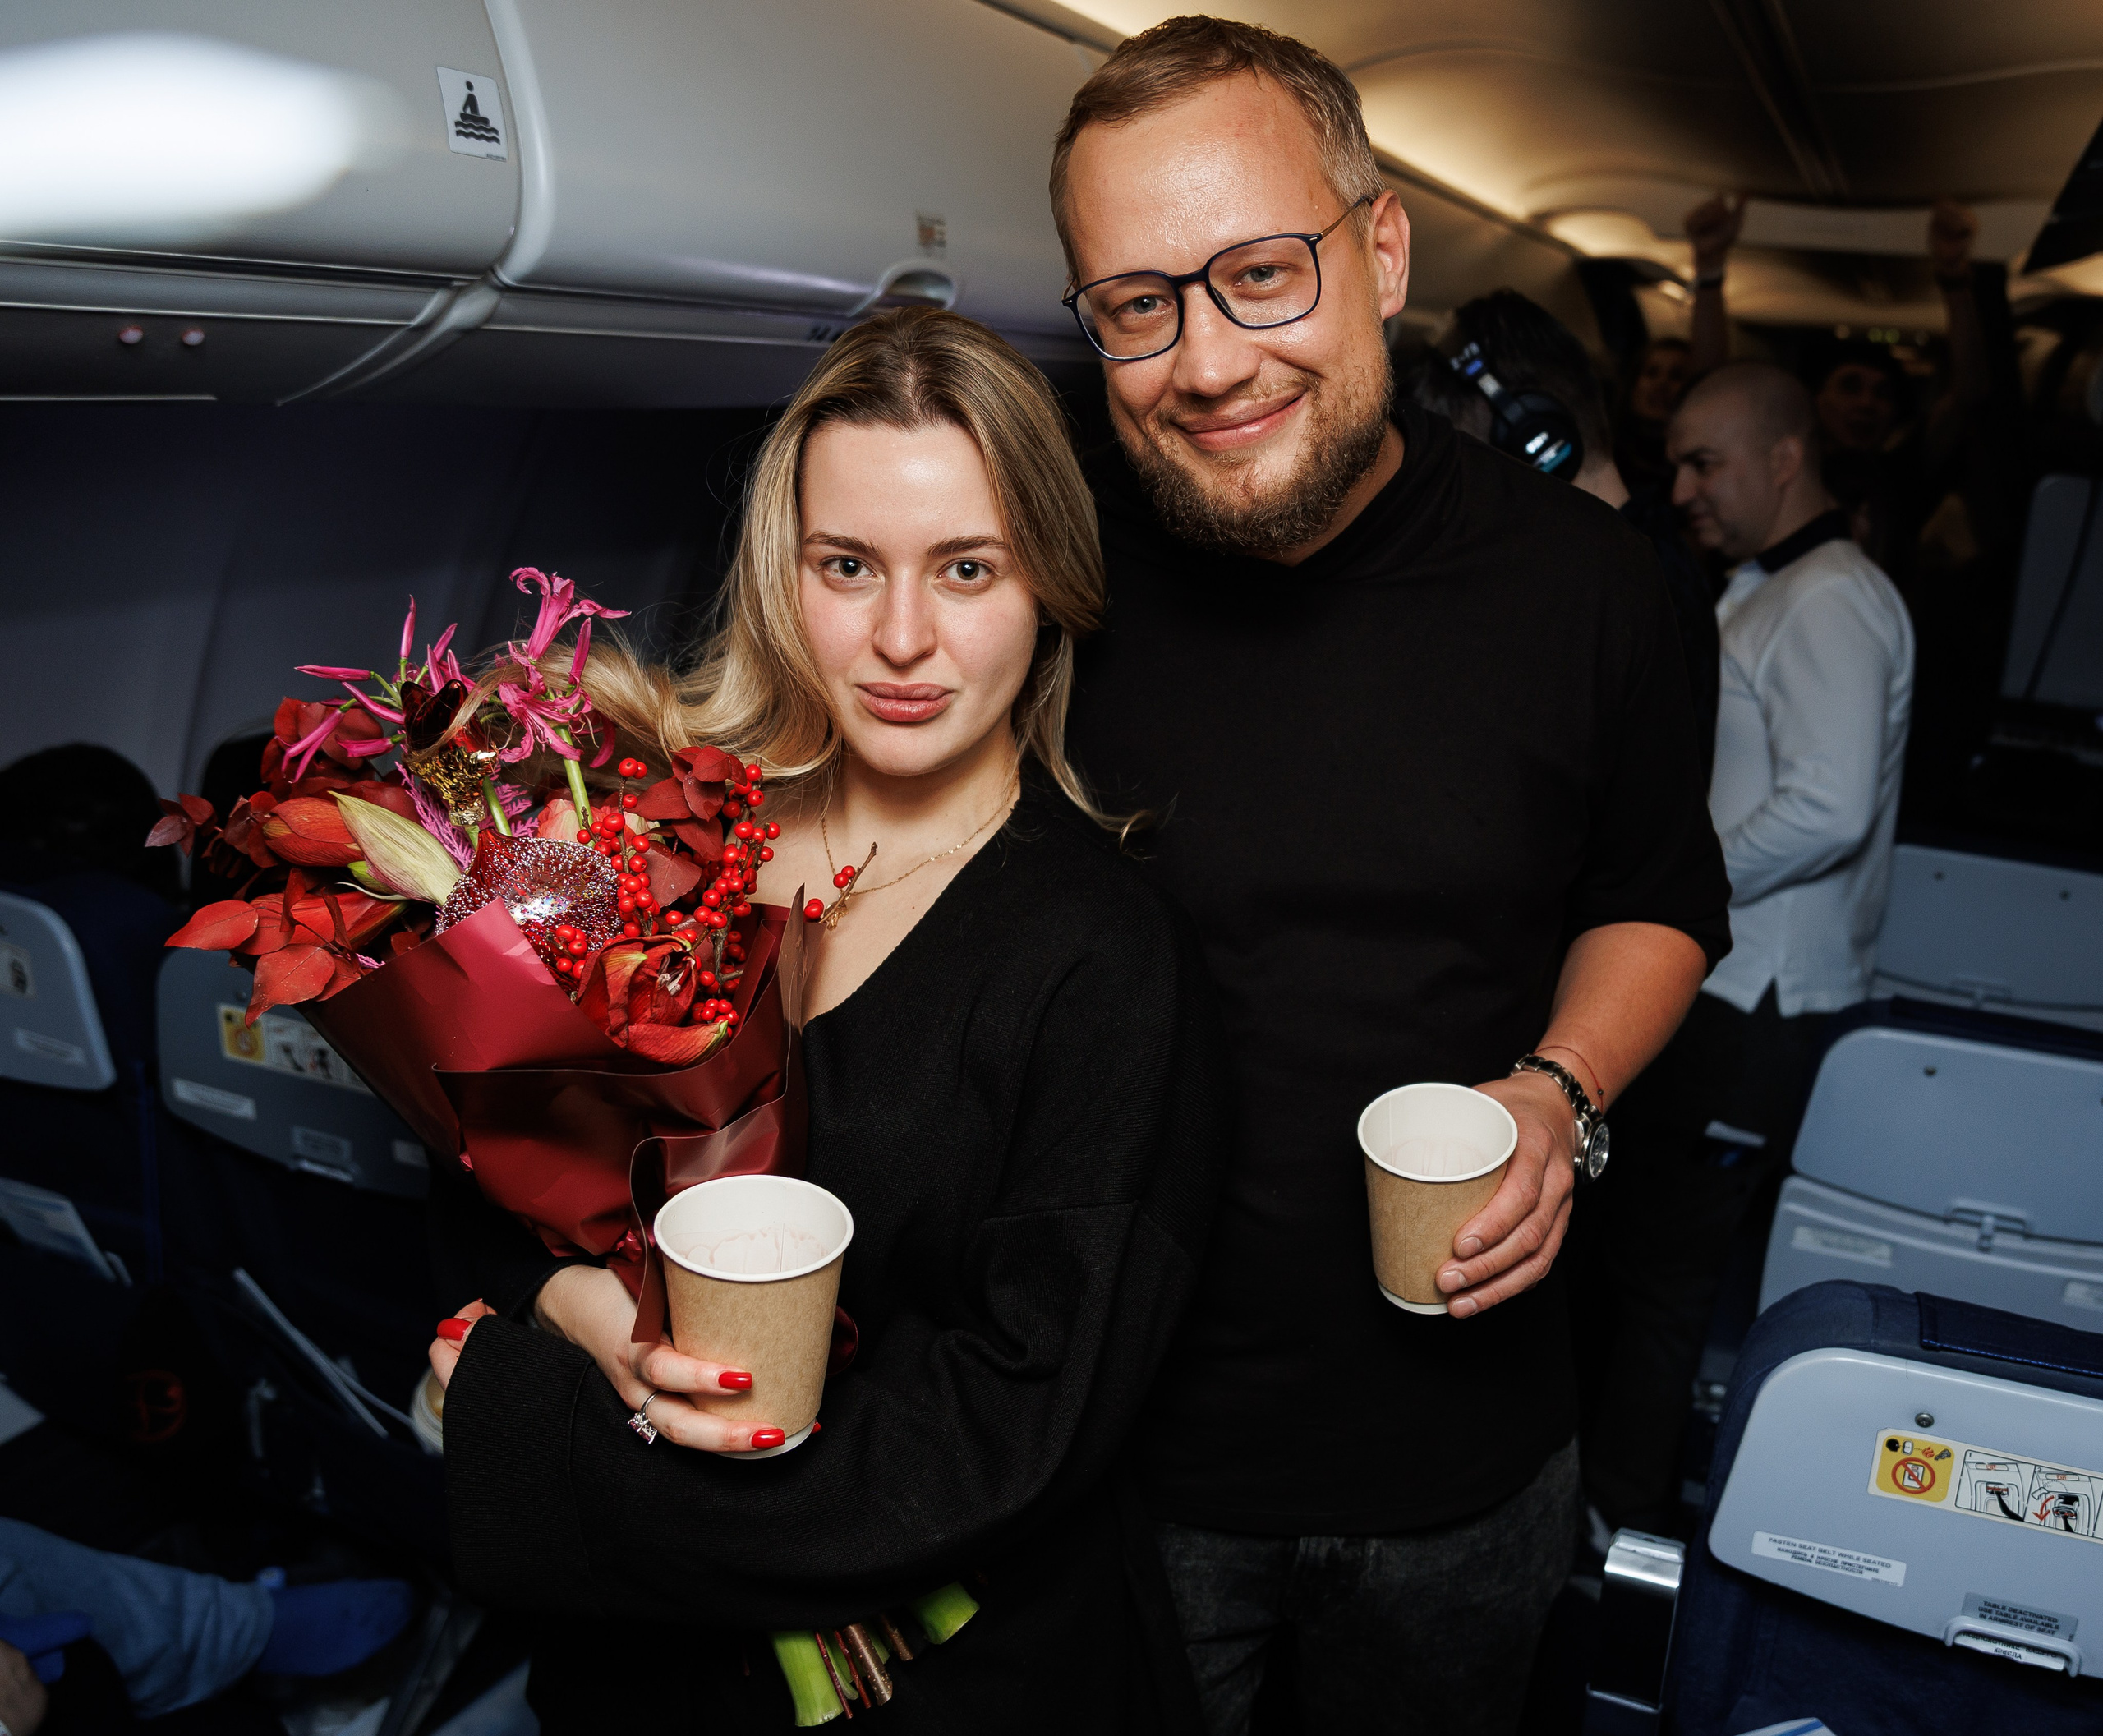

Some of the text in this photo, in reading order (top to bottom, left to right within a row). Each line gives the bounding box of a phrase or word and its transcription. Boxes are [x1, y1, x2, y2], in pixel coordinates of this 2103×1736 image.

[1768, 1537, 1892, 1568] FASTEN SEAT BELT WHILE SEATED
[1983, 1600, 2059, 1623] TABLE DEACTIVATED
[1995, 1609, 2018, 1620] TABLE
[2019, 1616, 2060, 1630] AVAILABLE
[1988, 1615, 2024, 1628] ARMREST
[2036, 1627, 2057, 1636] SEAT
[1994, 1647, 2022, 1660] КРЕСЛА
